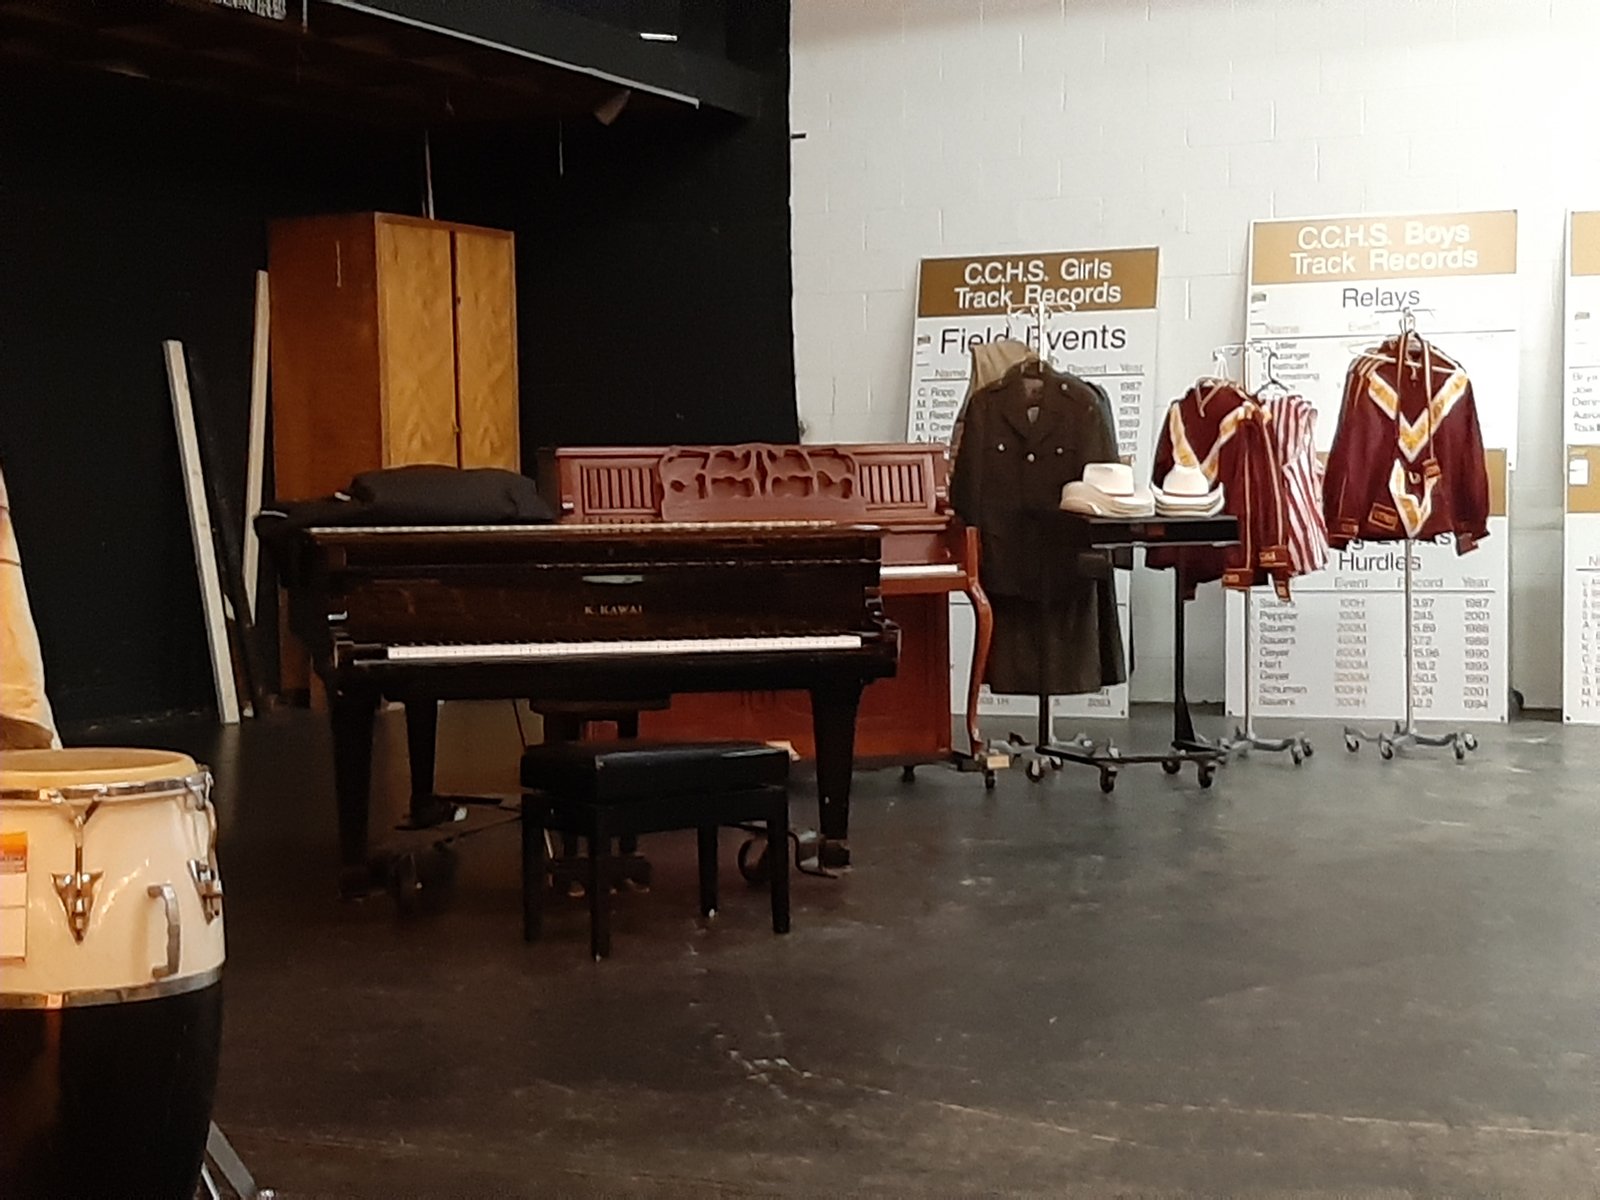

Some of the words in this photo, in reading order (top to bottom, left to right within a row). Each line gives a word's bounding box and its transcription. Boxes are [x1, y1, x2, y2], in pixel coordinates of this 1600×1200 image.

[1404, 220, 1471, 251] Boys
[964, 260, 1048, 284] C.C.H.S.
[1060, 257, 1113, 281] Girls
[1289, 251, 1356, 275] Track
[1368, 246, 1479, 272] Records
[954, 285, 1013, 309] Track
[1024, 281, 1122, 306] Records
[1342, 287, 1421, 312] Relays
[940, 326, 1010, 355] Field
[1026, 324, 1126, 350] Events
[1338, 552, 1421, 572] Hurdles
[1334, 577, 1368, 588] Event
[1397, 577, 1443, 588] Rcord
[1461, 577, 1490, 587] Year
[600, 604, 642, 616] KAWAI
[1464, 611, 1490, 621] 2001
